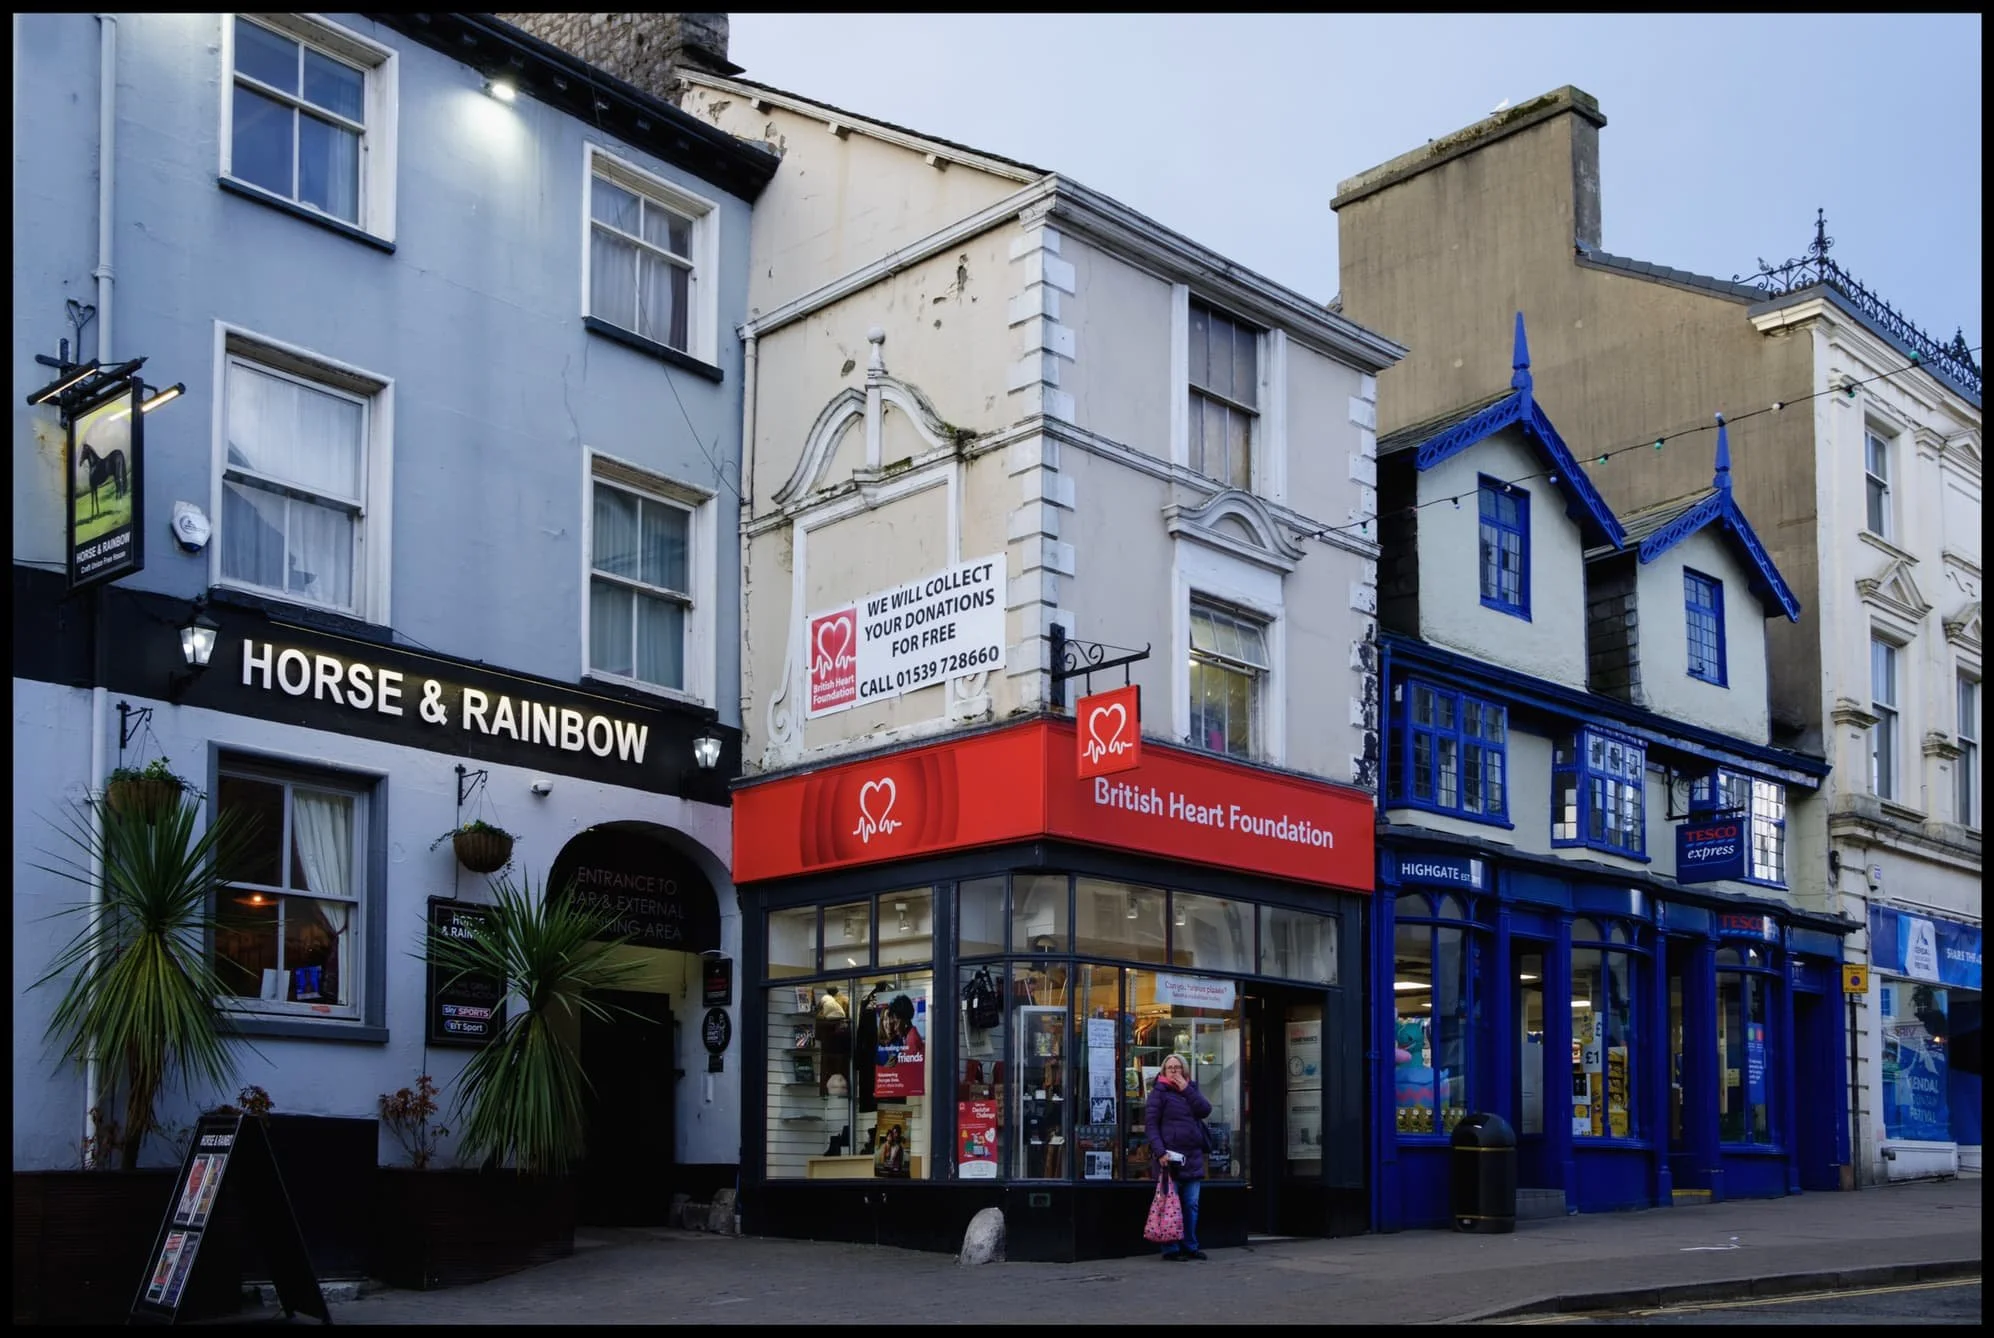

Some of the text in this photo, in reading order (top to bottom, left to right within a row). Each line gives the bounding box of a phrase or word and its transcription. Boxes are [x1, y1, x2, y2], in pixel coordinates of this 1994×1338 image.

[76, 531, 131, 564] HORSE & RAINBOW
[867, 563, 993, 617] WE WILL COLLECT
[865, 588, 995, 642] YOUR DONATIONS
[892, 623, 956, 658] FOR FREE
[860, 645, 1000, 698] CALL 01539 728660
[813, 674, 855, 695] British Heart
[242, 639, 649, 763] HORSE & RAINBOW
[812, 687, 855, 705] Foundation
[1094, 776, 1333, 848] British Heart Foundation
[1685, 825, 1737, 842] TESCO
[1687, 844, 1735, 860] express
[577, 866, 678, 896] ENTRANCE TO
[1401, 863, 1459, 880] HIGHGATE
[601, 894, 612, 909] &
[616, 895, 684, 919] EXTERNAL
[441, 926, 449, 937] &
[644, 922, 683, 941] AREA
[1720, 914, 1764, 931] TESC
[1946, 948, 1966, 961] SHARE
[444, 1006, 489, 1018] sky SPORTS
[450, 1022, 483, 1032] BT Sport
[897, 1052, 924, 1064] friends
[1585, 1051, 1600, 1064] £1
[1907, 1075, 1940, 1094] KENDAL
